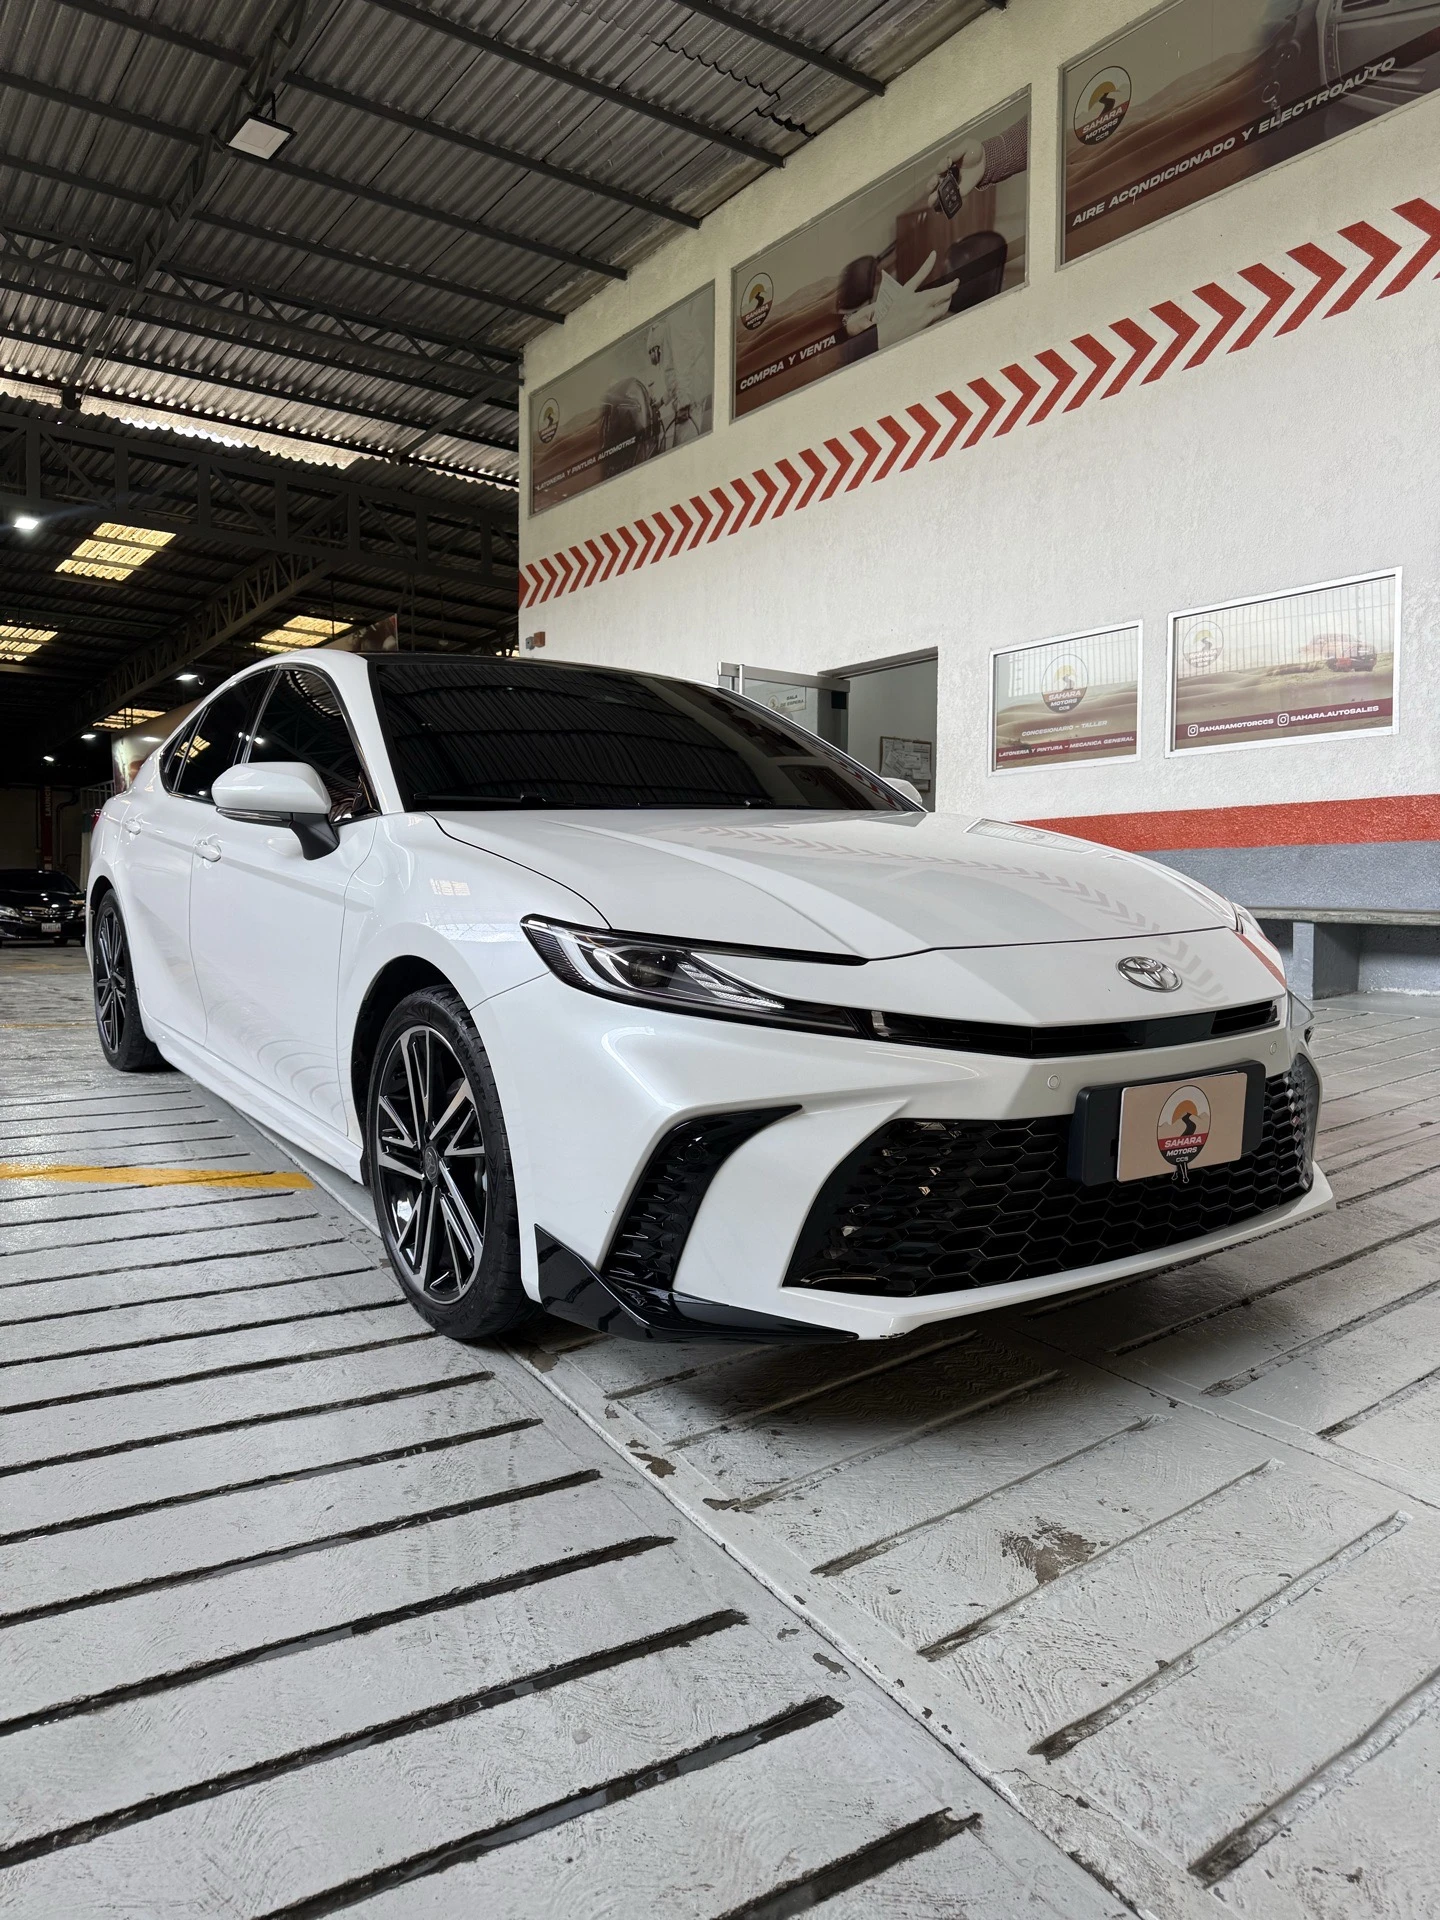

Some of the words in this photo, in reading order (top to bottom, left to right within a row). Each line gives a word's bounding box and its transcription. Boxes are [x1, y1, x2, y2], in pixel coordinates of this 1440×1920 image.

[1082, 105, 1124, 134] SAHARA
[1084, 117, 1119, 142] MOTORS
[1095, 130, 1109, 142] CCS
[1072, 202, 1105, 227] AIRE
[1108, 138, 1236, 209] ACONDICIONADO
[1241, 127, 1255, 142] Y
[1258, 56, 1396, 134] ELECTROAUTO
[745, 303, 769, 321] SAHARA
[740, 363, 784, 390] COMPRA
[788, 354, 796, 365] Y
[800, 334, 836, 359] VENTA
[571, 457, 596, 473] PINTURA
[598, 436, 636, 460] AUTOMOTRIZ
[1048, 690, 1081, 701] SAHARA
[1050, 698, 1078, 706] MOTORS
[1290, 706, 1379, 721] SAHARA.AUTOSALES
[1021, 725, 1073, 736] CONCESIONARIO
[1081, 720, 1108, 729] TALLER
[998, 749, 1029, 757] LATONERIA
[451, 1028, 487, 1100] DUNLOP
[1164, 1136, 1202, 1149] SAHARA
[1166, 1146, 1198, 1157] MOTORS
